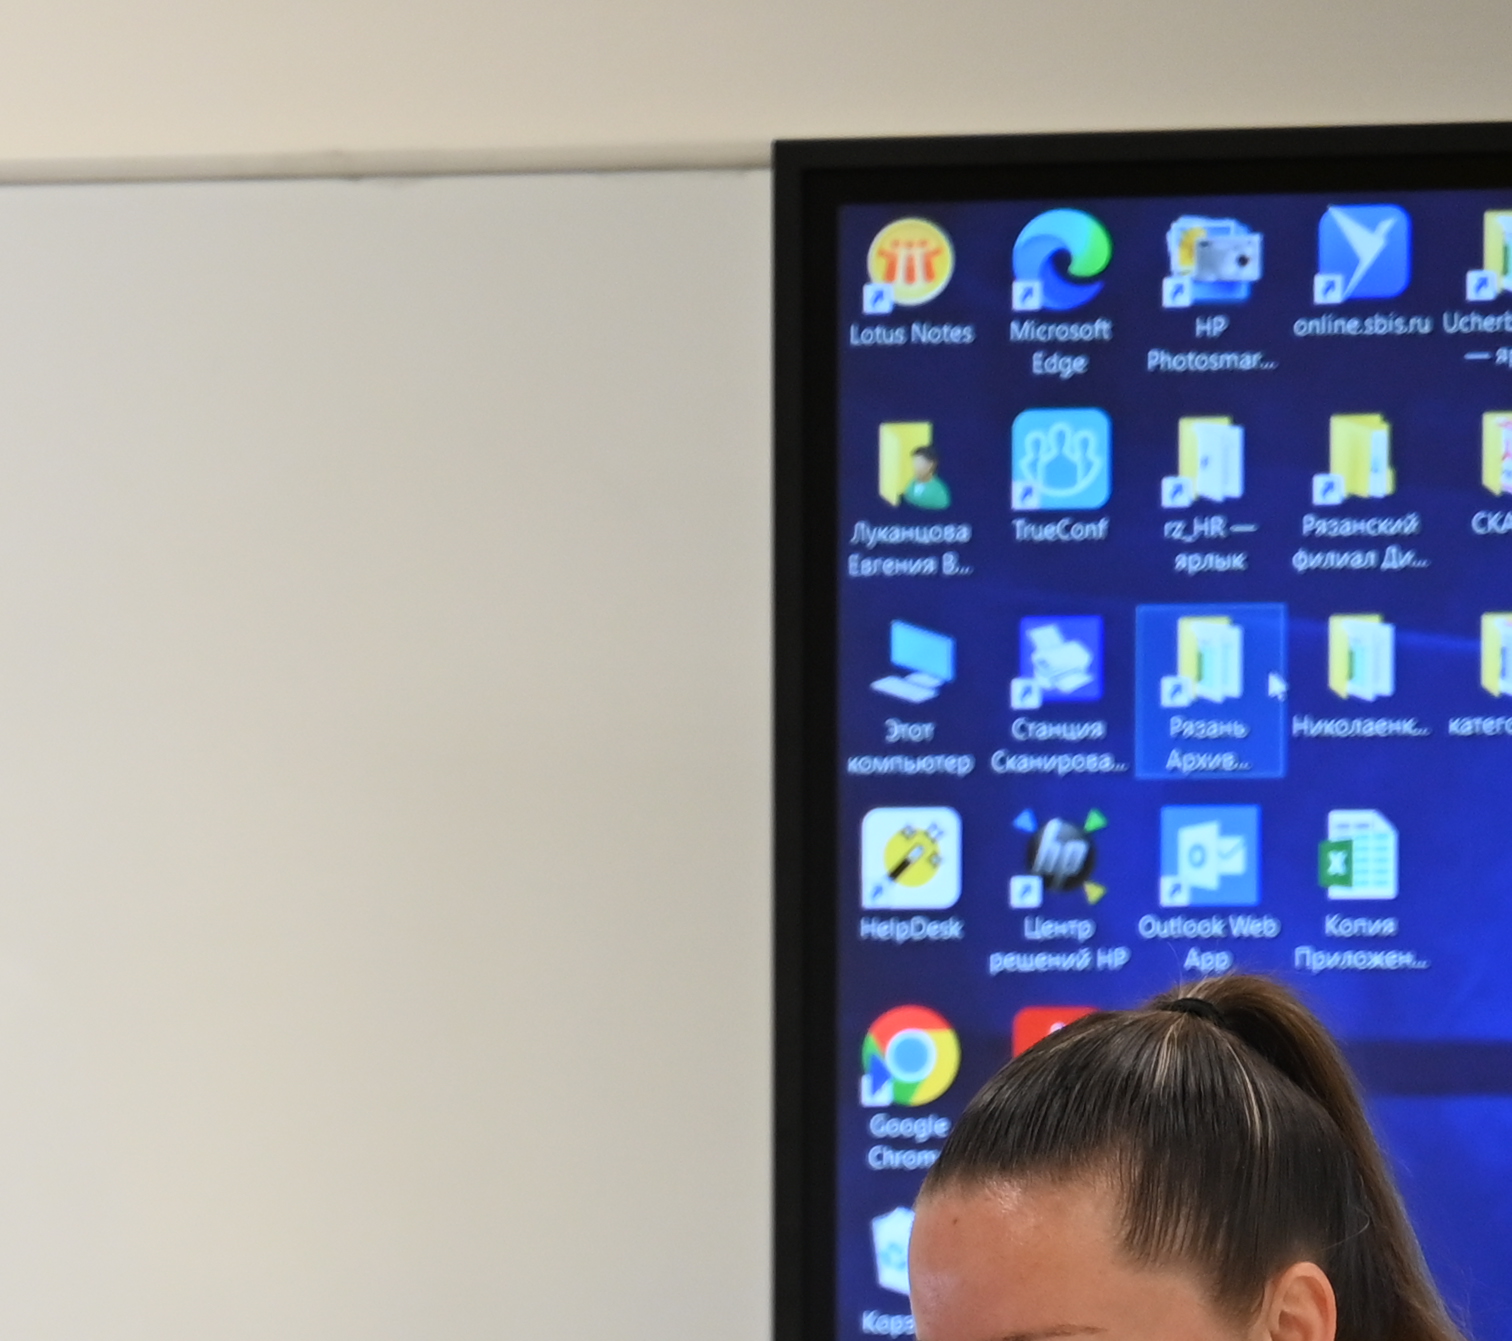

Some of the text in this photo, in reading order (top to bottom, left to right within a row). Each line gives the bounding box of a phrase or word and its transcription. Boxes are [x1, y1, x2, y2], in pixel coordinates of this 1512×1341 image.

[849, 322, 975, 347] Lotus Notes
[1009, 317, 1112, 343] Microsoft
[1195, 314, 1229, 338] HP
[1292, 312, 1433, 338] online.sbis.ru
[1031, 350, 1089, 380] Edge
[849, 520, 972, 550] Луканцова
[1011, 517, 1109, 542] TrueConf
[1163, 514, 1227, 543] rz_HR
[1302, 512, 1420, 538] Рязанский
[847, 553, 938, 578] Евгения
[1174, 552, 1247, 575] ярлык
[1291, 547, 1378, 573] филиал
[884, 718, 935, 743] Этот
[1010, 716, 1106, 742] Станция
[1169, 714, 1249, 739] Рязань
[846, 754, 975, 777] компьютер
[859, 915, 964, 944] HelpDesk
[1023, 916, 1096, 943] Центр
[1137, 914, 1281, 939] Outlook Web
[1324, 913, 1398, 938] Копия
[988, 946, 1130, 976] решений HP
[1183, 947, 1233, 974] App
[868, 1112, 951, 1144] Google
[868, 1144, 942, 1170] Chrom
